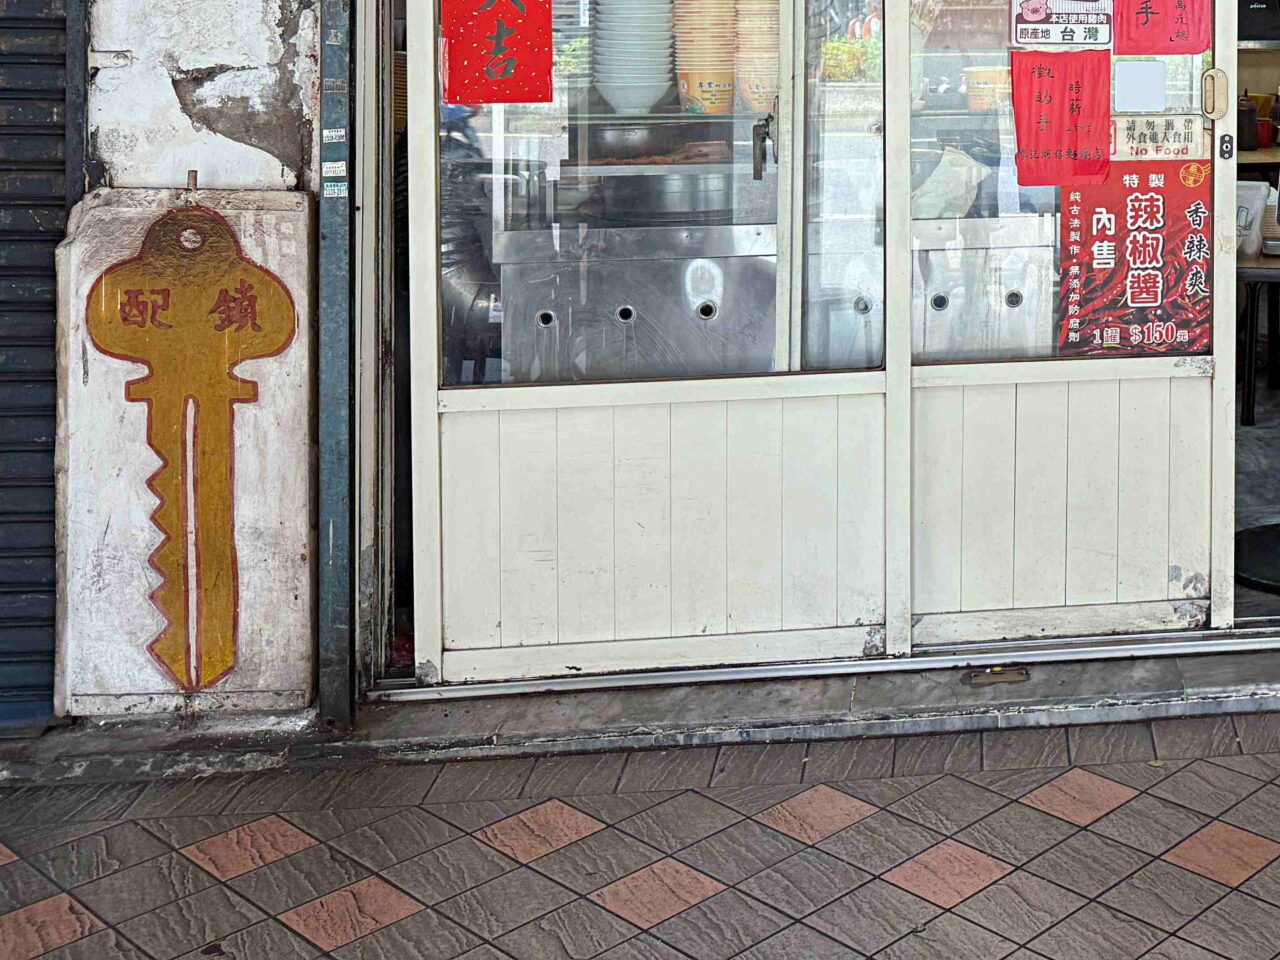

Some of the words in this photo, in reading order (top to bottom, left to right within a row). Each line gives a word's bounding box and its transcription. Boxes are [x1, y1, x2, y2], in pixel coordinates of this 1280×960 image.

[1049, 14, 1107, 24] 本店使用豬肉
[1019, 27, 1051, 40] 原產地
[1060, 26, 1099, 42] 台灣
[1126, 119, 1194, 131] 請勿攜帶
[1130, 145, 1148, 156] No
[1155, 145, 1189, 155] Food
[1122, 173, 1166, 188] 特製
[1091, 207, 1116, 269] 內售
[1126, 192, 1164, 308] 辣椒醬
[1183, 200, 1210, 296] 香辣爽
[1092, 327, 1120, 344] 1罐
